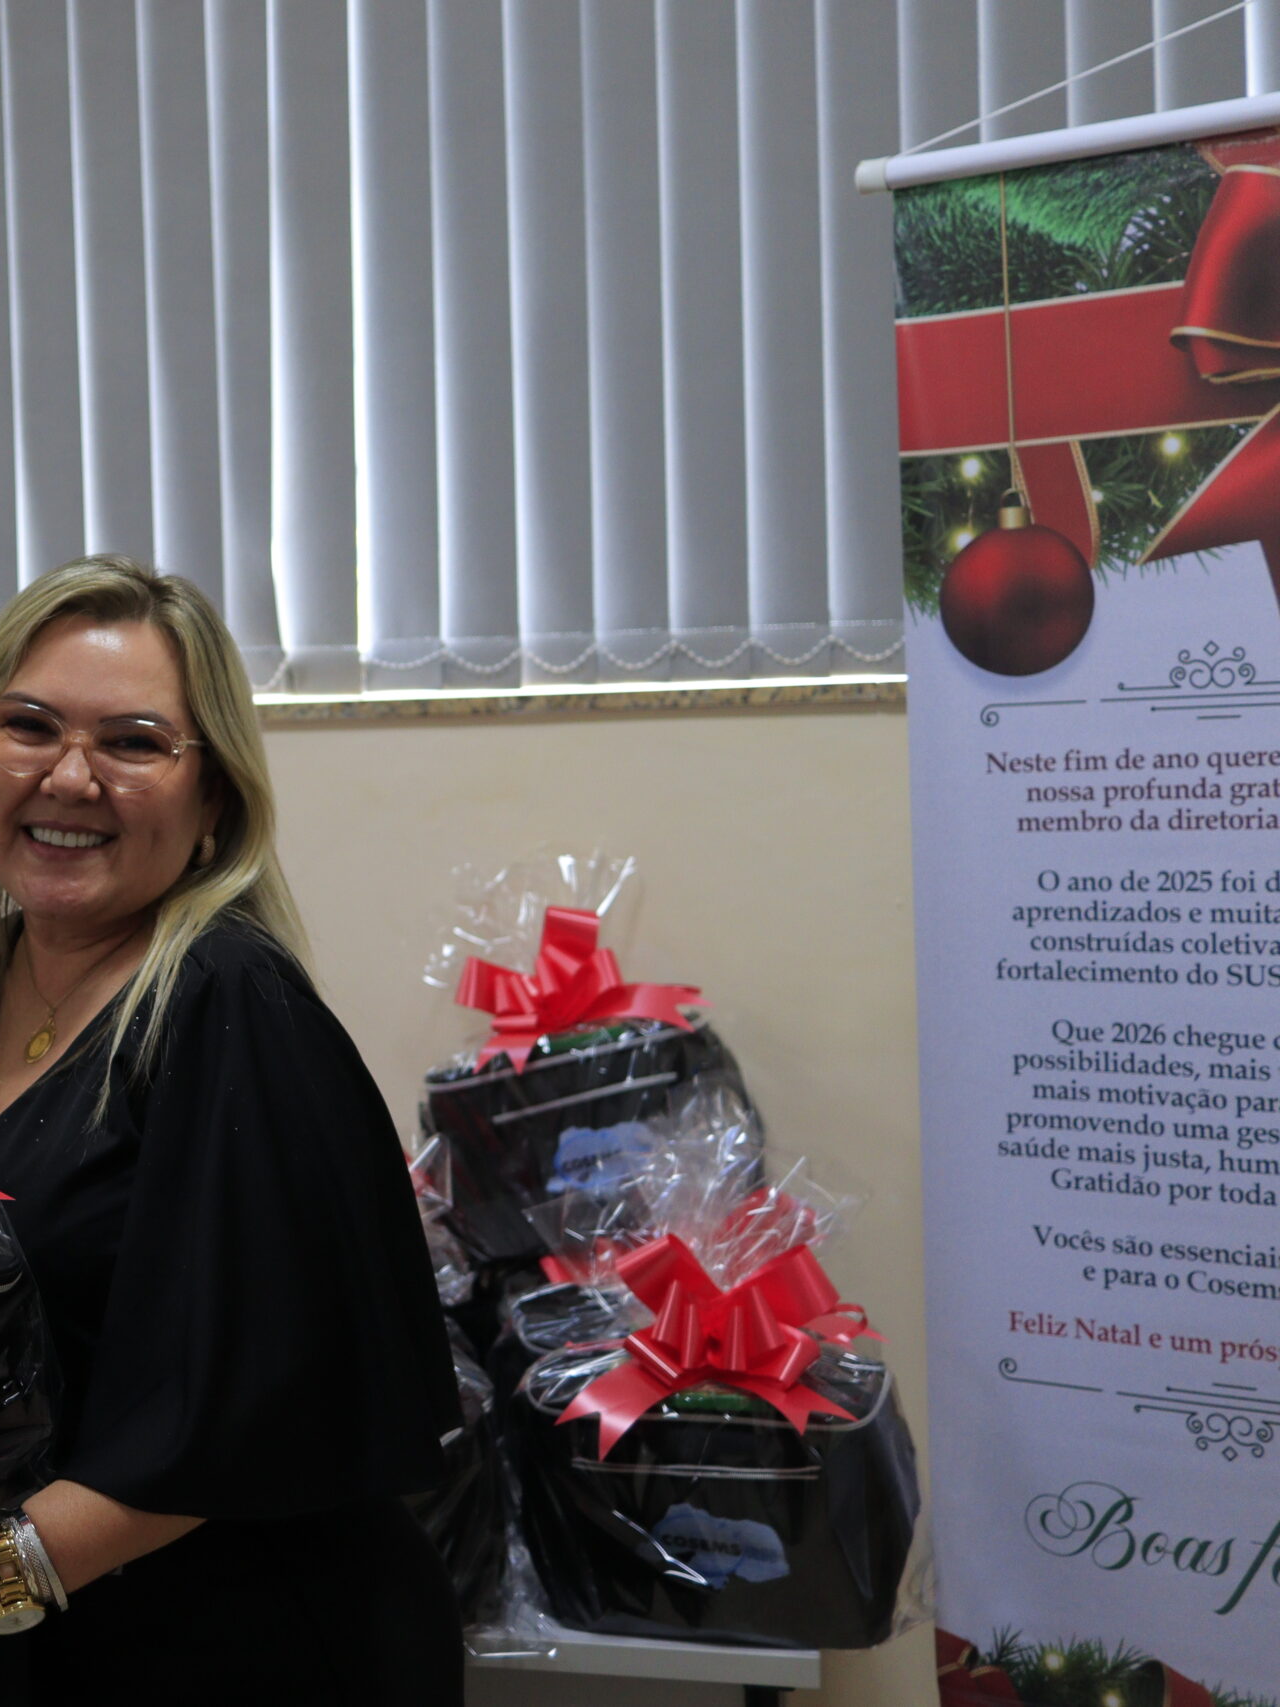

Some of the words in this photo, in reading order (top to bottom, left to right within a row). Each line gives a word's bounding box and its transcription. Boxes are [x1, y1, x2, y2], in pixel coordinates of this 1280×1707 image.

[986, 751, 1056, 774] Neste
[1064, 749, 1107, 772] fim
[1115, 748, 1145, 770] de
[1152, 752, 1199, 770] ano
[1027, 785, 1095, 803] nossa
[1104, 777, 1221, 808] profunda
[1017, 810, 1122, 832] membro
[1130, 809, 1159, 831] da
[1037, 869, 1060, 892] O
[1067, 876, 1113, 892] ano
[1120, 870, 1150, 892] de
[1157, 870, 1213, 892] 2025
[1220, 870, 1256, 892] foi
[1012, 901, 1181, 927] aprendizados
[1189, 907, 1202, 923] e
[1030, 930, 1174, 954] construídas
[995, 959, 1178, 983] fortalecimento
[1186, 963, 1218, 985] do
[1051, 1019, 1104, 1044] Que
[1111, 1022, 1166, 1044] 2026
[1173, 1025, 1265, 1055] chegue
[1013, 1050, 1201, 1081] possibilidades,
[1208, 1058, 1271, 1081] mais
[1032, 1079, 1090, 1102] mais
[1098, 1084, 1227, 1115] motivação
[1235, 1097, 1280, 1118] par
[1006, 1112, 1165, 1137] promovendo
[1173, 1121, 1229, 1141] uma
[998, 1137, 1070, 1160] saúde
[1077, 1142, 1136, 1165] mais
[1141, 1145, 1211, 1173] justa,
[1051, 1168, 1161, 1197] Gratidão
[1168, 1182, 1212, 1206] por
[1219, 1183, 1277, 1206] toda
[1032, 1225, 1106, 1252] Vocês
[1112, 1234, 1153, 1257] são
[1160, 1241, 1280, 1269] essenciai
[1082, 1266, 1097, 1281] e
[1103, 1266, 1157, 1290] para
[1164, 1274, 1180, 1290] o
[1187, 1270, 1280, 1301] Cosem
[1008, 1310, 1068, 1338] Feliz
[1074, 1318, 1142, 1346] Natal
[1148, 1332, 1163, 1349] e
[1170, 1336, 1213, 1355] um
[1025, 1481, 1237, 1577] Boas
